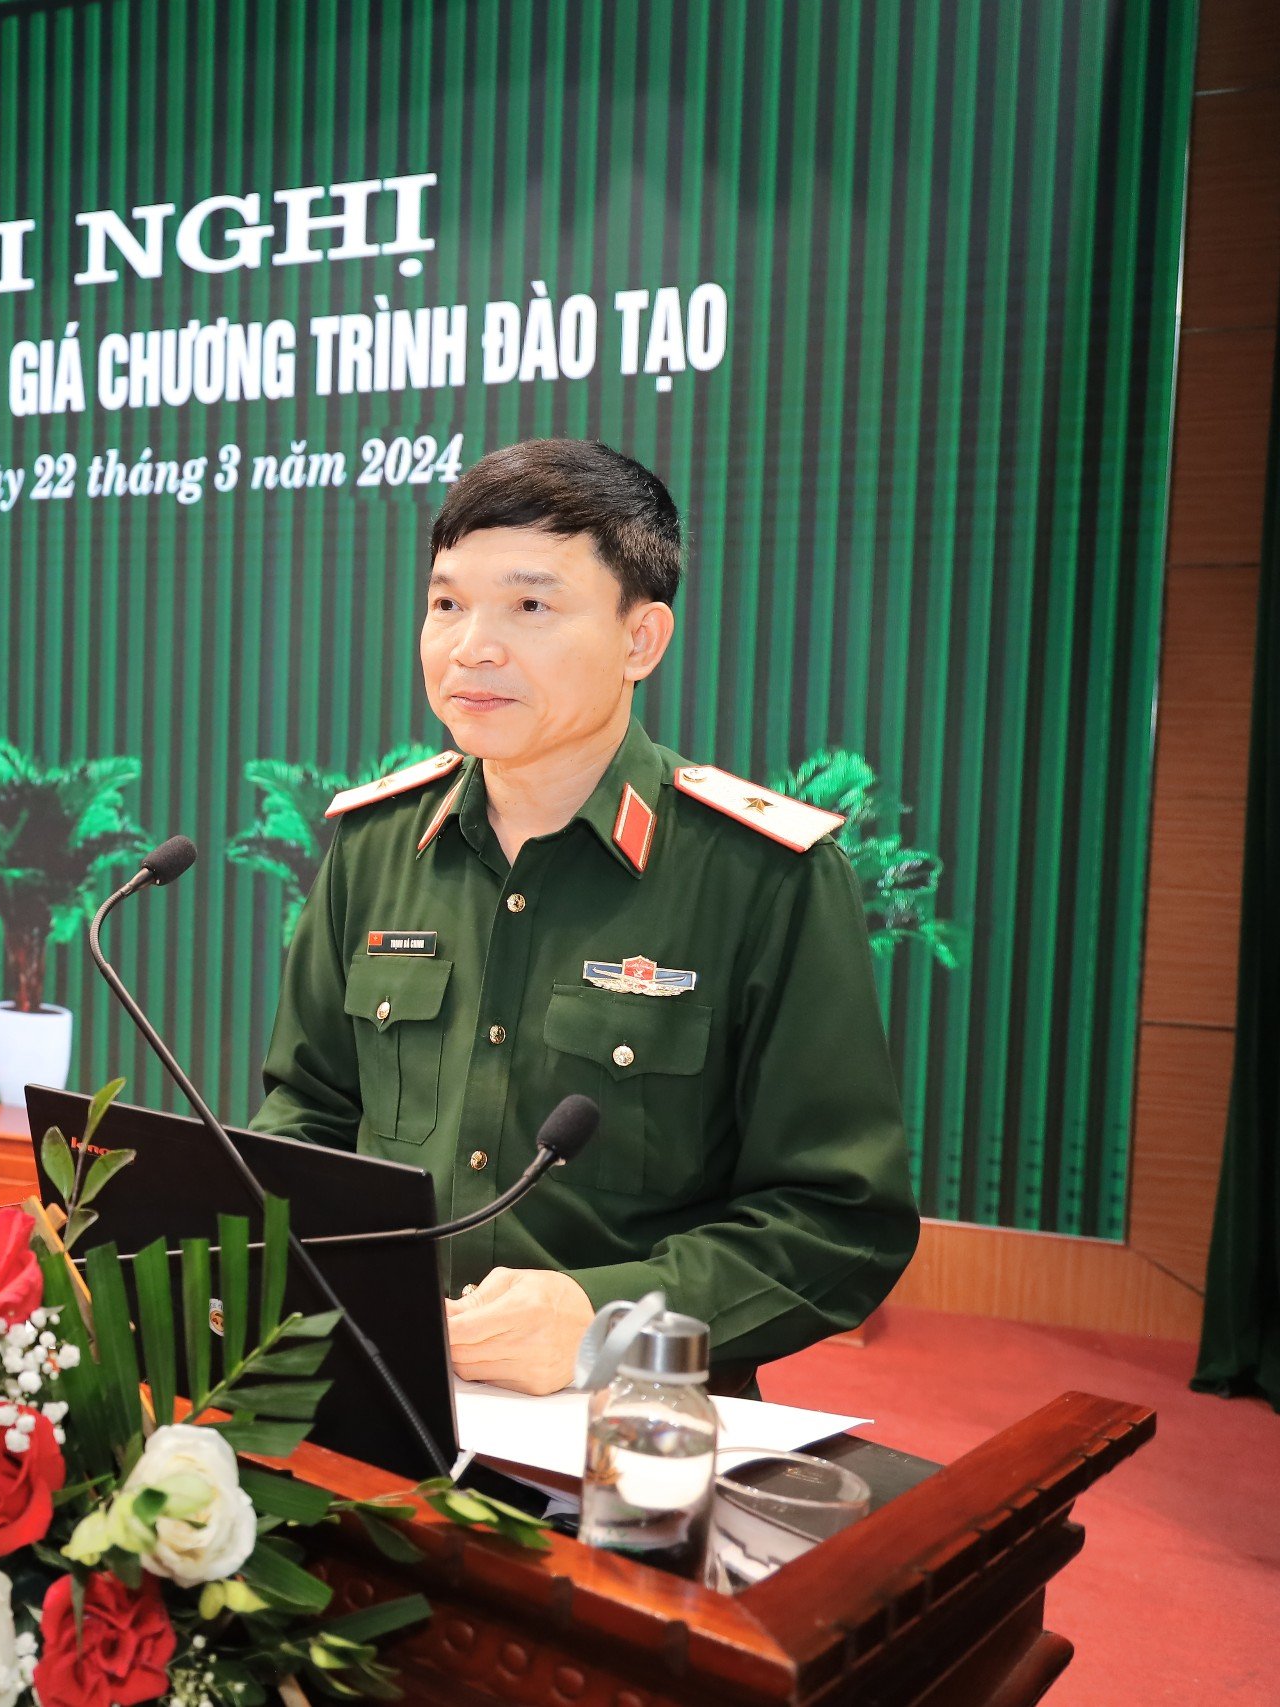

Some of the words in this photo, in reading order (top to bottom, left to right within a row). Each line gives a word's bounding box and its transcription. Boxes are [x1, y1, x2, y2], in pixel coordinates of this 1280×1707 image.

[74, 173, 436, 285] NGHỊ
[9, 321, 85, 417] GIÁ
[98, 317, 296, 411] CHƯƠNG
[311, 295, 467, 395] TRÌNH
[482, 281, 597, 385] ĐÀO
[615, 283, 727, 392] TẠO
[30, 453, 76, 500] 22
[87, 447, 207, 505] tháng
[214, 445, 240, 491] 3
[251, 441, 346, 490] năm
[357, 434, 463, 487] 2024
